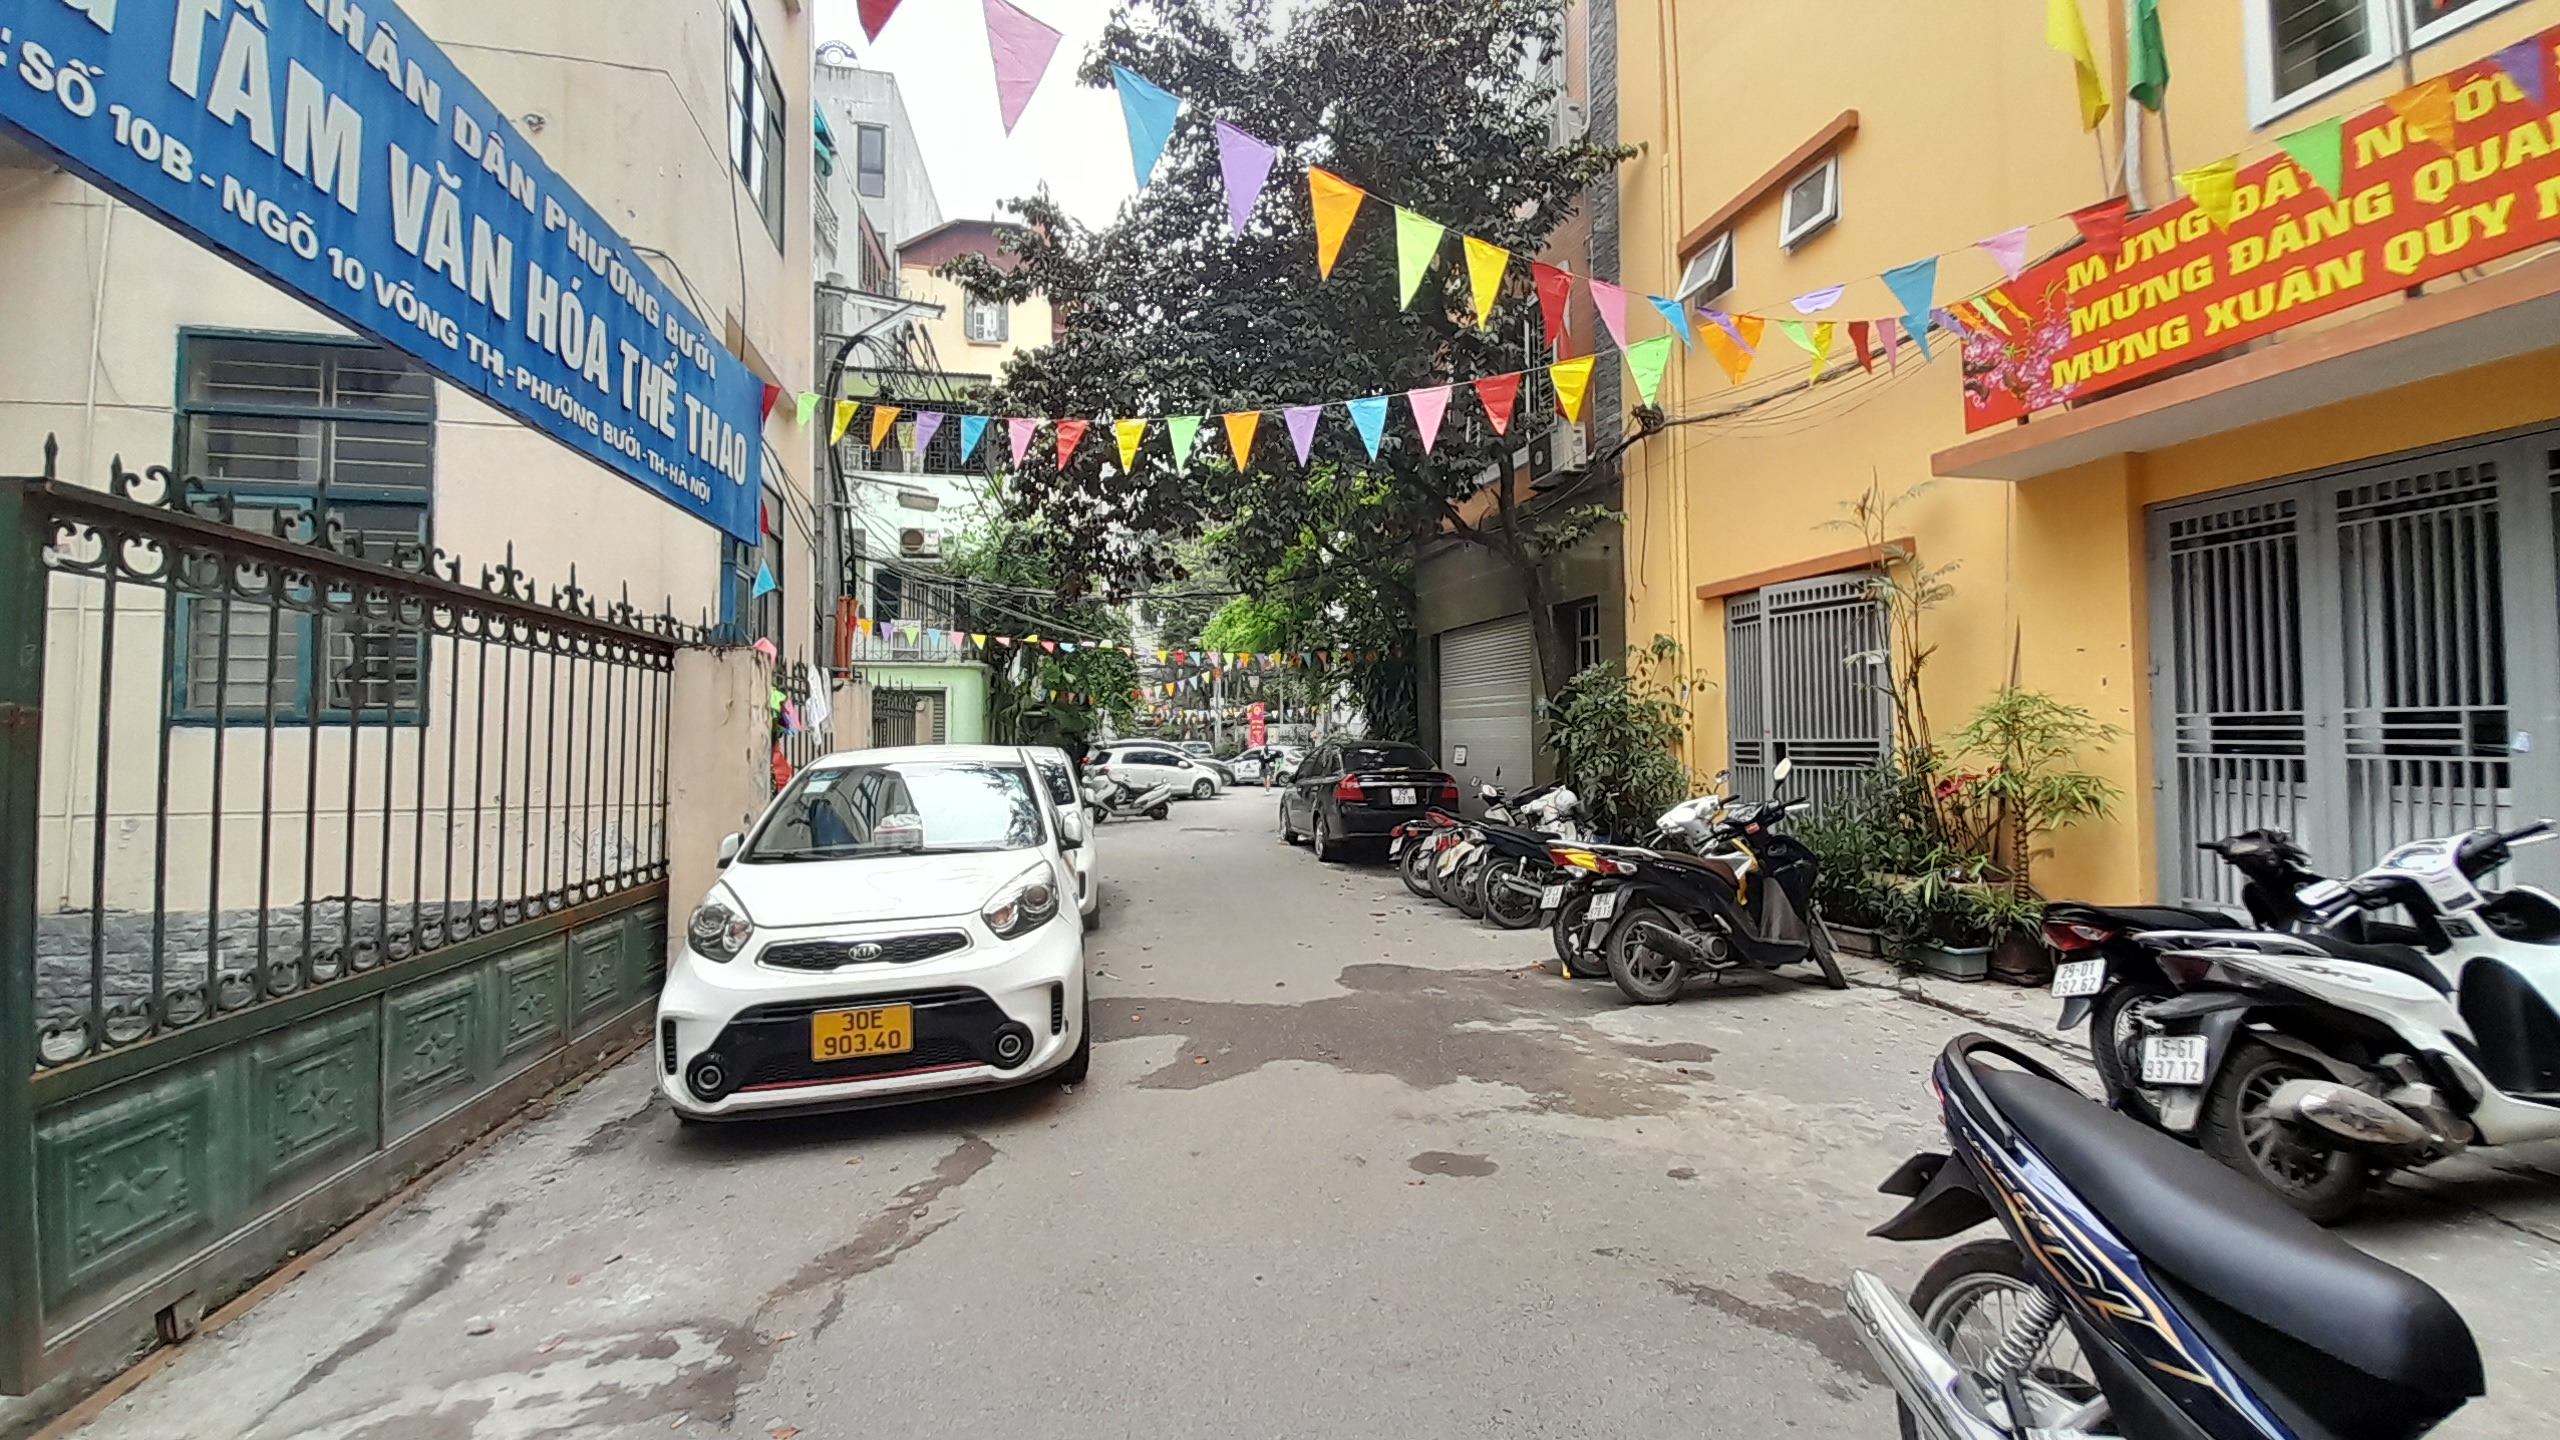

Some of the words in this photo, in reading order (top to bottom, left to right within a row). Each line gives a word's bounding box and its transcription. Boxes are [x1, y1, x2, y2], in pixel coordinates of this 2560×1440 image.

[168, 0, 363, 214] TÂM
[388, 141, 514, 322] VĂN
[525, 261, 611, 395] HÓA
[618, 337, 678, 441] THỂ
[684, 392, 748, 486] THAO
[452, 105, 537, 215] DÂN
[543, 194, 661, 330] PHƯỜNG
[664, 313, 717, 380] BƯỞI
[2069, 254, 2215, 339] MỪNG
[2227, 181, 2395, 277] ĐẢNG
[2229, 154, 2324, 226] ĐẤ
[222, 173, 320, 261] NGÕ
[327, 247, 367, 291] 10
[373, 271, 461, 350] VÕNG
[690, 476, 711, 506] NỘI
[2051, 314, 2192, 391] MỪNG
[2203, 249, 2367, 338] XUÂN
[842, 1009, 885, 1032] 30E
[852, 945, 877, 959] KIA
[823, 1029, 902, 1056] 903.40
